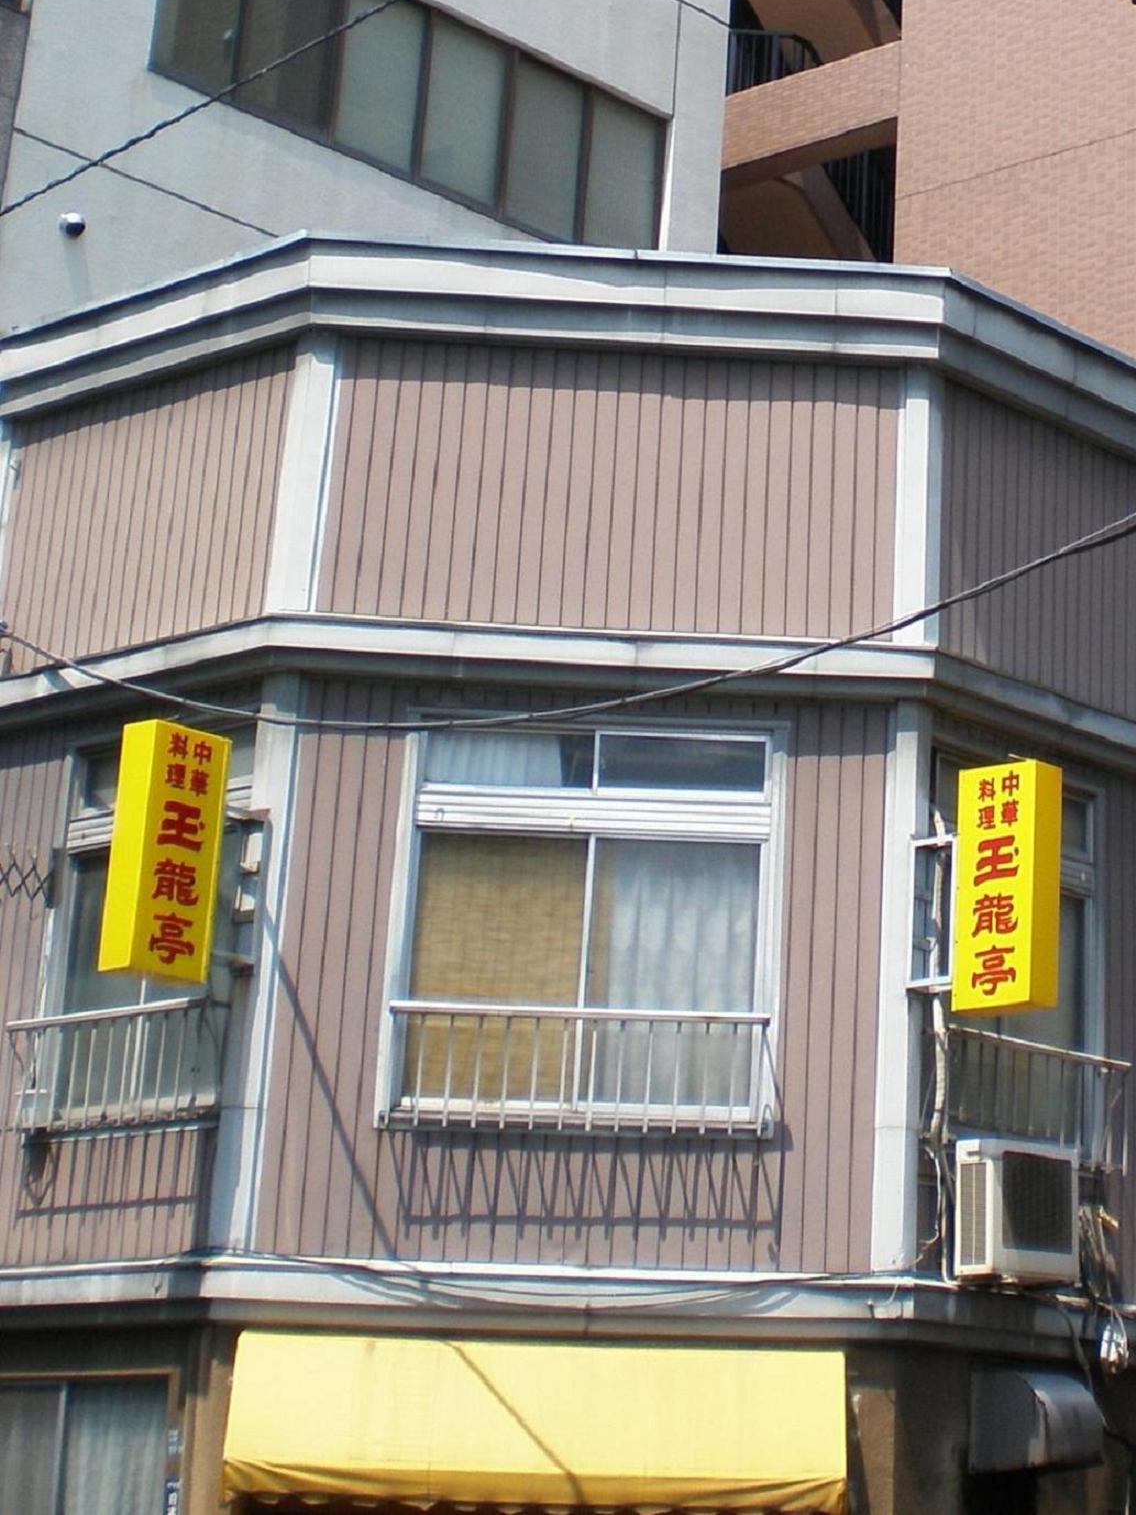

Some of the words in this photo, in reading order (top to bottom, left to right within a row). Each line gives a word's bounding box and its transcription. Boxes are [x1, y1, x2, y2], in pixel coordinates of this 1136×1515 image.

[164, 732, 188, 790] 料理
[190, 740, 213, 797] 中華
[977, 777, 996, 830] 料理
[1001, 770, 1020, 827] 中華
[149, 800, 206, 965] 玉龍亭
[971, 834, 1020, 996] 玉龍亭
